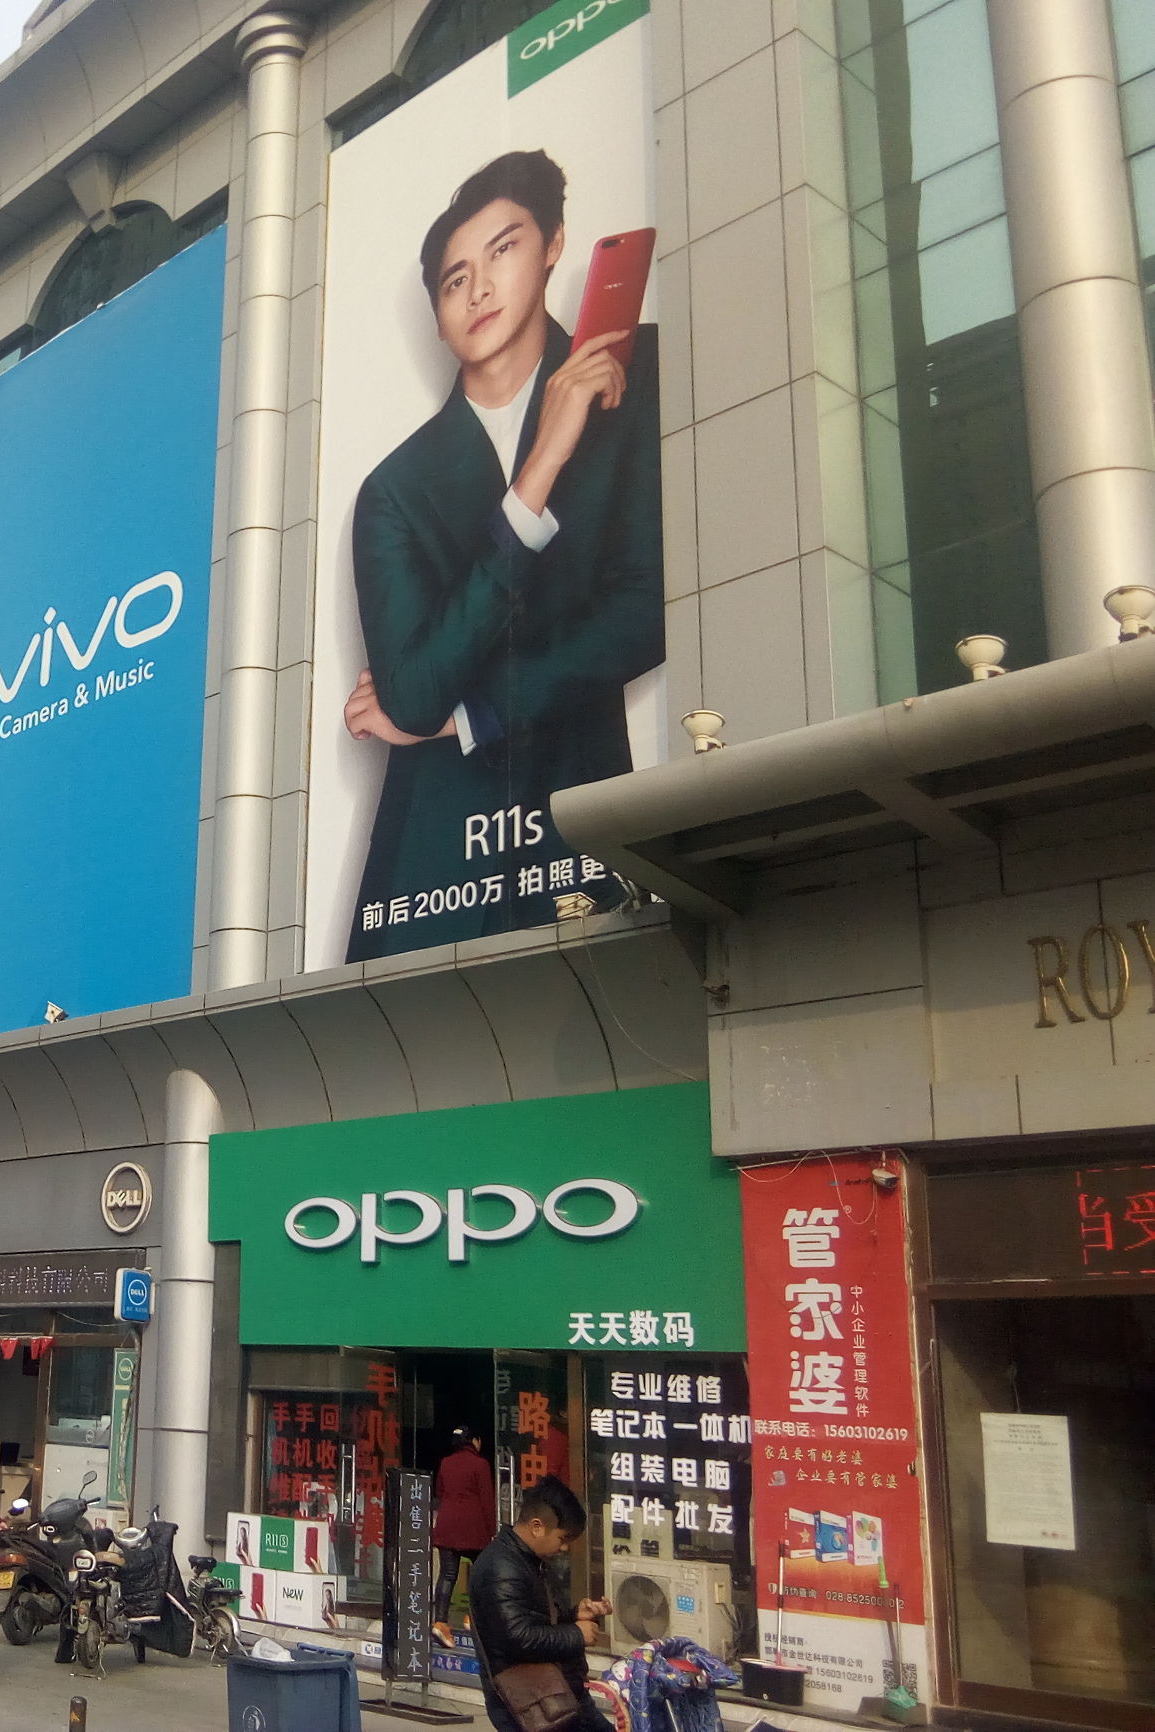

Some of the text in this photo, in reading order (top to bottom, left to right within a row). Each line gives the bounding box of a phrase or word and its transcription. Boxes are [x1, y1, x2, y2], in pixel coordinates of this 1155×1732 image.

[520, 0, 622, 60] opp
[74, 683, 89, 708] &
[95, 657, 155, 701] Music
[464, 804, 544, 861] R11s
[361, 874, 505, 932] 前后2000万
[106, 1189, 142, 1209] DELL
[568, 1310, 694, 1348] 天天数码
[782, 1207, 849, 1415] 管家婆
[850, 1285, 870, 1418] 中小企业管理软件
[611, 1371, 722, 1404] 专业维修
[590, 1408, 752, 1444] 笔记本一体机
[824, 1424, 908, 1441] 15603102619
[610, 1452, 731, 1491] 组装电脑
[610, 1493, 734, 1535] 配件批发
